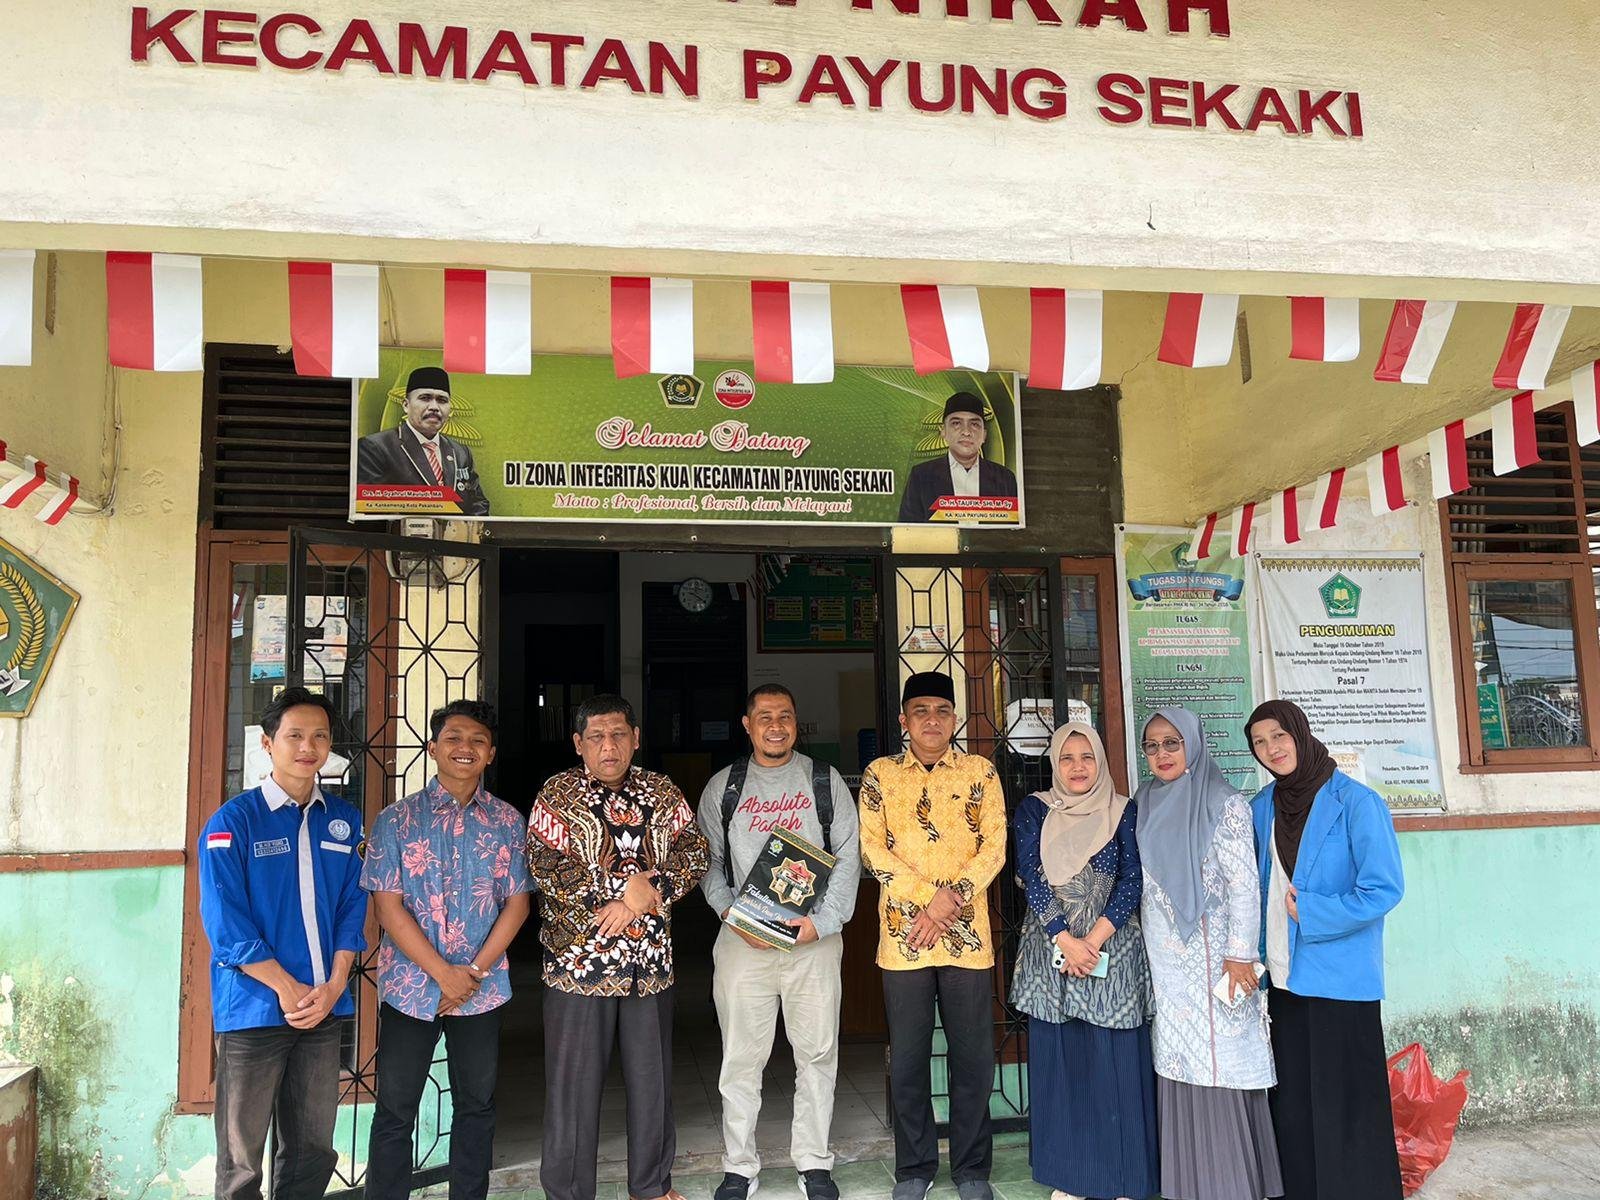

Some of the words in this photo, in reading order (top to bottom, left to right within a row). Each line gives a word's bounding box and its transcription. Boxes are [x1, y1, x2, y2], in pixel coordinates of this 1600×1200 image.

[130, 6, 699, 99] KECAMATAN
[743, 48, 1068, 123] PAYUNG
[1096, 72, 1363, 139] SEKAKI
[597, 417, 707, 448] Selamat
[710, 420, 809, 457] Datang
[505, 462, 520, 486] DI
[525, 463, 567, 486] ZONA
[571, 464, 656, 488] INTEGRITAS
[660, 466, 689, 488] KUA
[693, 466, 780, 490] KECAMATAN
[784, 469, 839, 492] PAYUNG
[844, 470, 893, 492] SEKAKI
[554, 494, 598, 508] Motto
[612, 494, 698, 513] Profesional,
[701, 495, 748, 510] Bersih
[752, 498, 780, 511] dan
[782, 498, 852, 516] Melayani
[1004, 501, 1012, 509] Sy
[1148, 576, 1175, 586] TUGAS
[1177, 576, 1194, 584] DAN
[1195, 576, 1224, 586] FUNGSI
[1300, 625, 1395, 637] PENGUMUMAN
[1337, 676, 1358, 685] Pasal
[1360, 676, 1365, 685] 7
[738, 791, 812, 813] Absolute
[748, 811, 803, 832] Padeh
